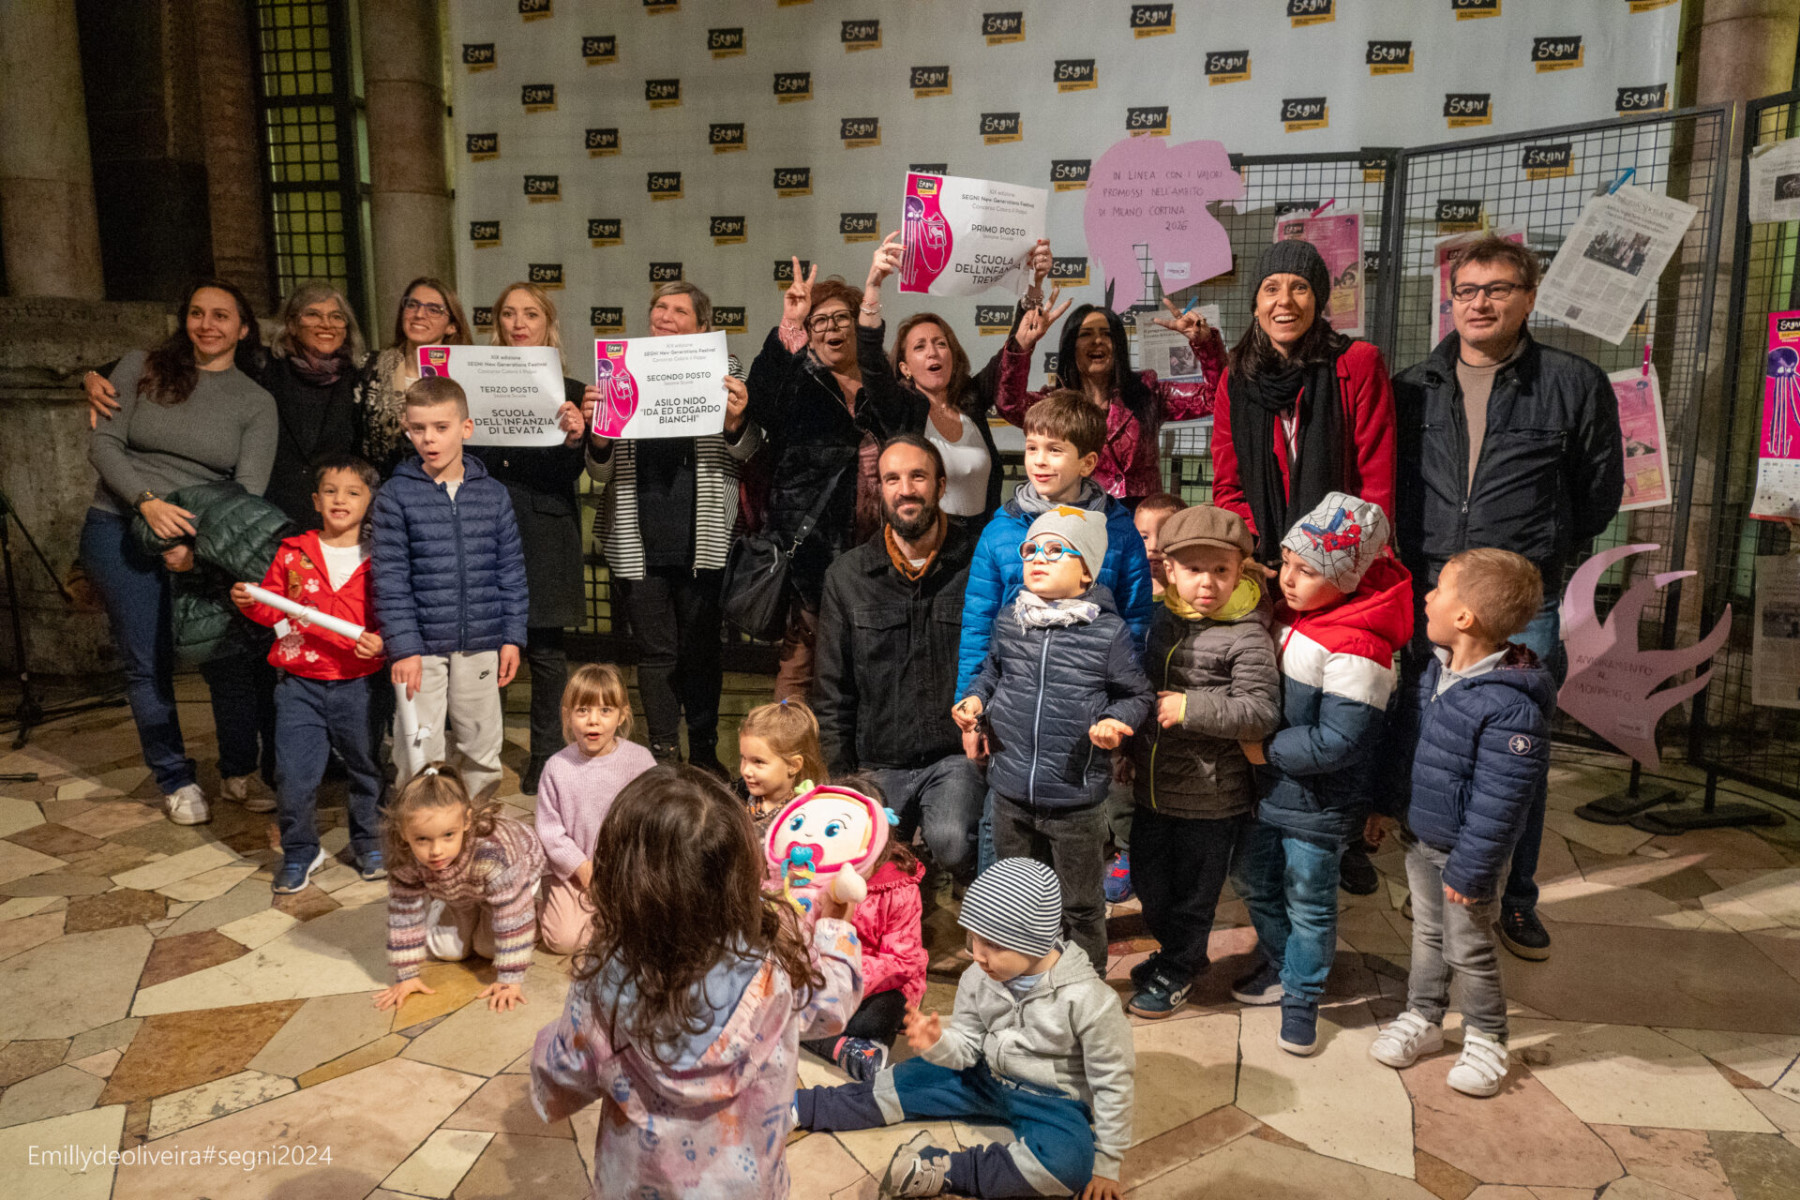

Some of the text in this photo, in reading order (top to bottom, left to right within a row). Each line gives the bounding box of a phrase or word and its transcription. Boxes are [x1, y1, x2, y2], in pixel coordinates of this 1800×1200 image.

[1136, 9, 1168, 24] Segni
[987, 17, 1017, 32] Segni
[845, 25, 874, 39] Segni
[711, 33, 739, 46] Segni
[1371, 45, 1406, 61] Segni
[1538, 41, 1575, 58] Segni
[1210, 55, 1243, 70] Segni
[915, 70, 944, 85] Segni
[1059, 64, 1089, 79] Segni
[778, 76, 806, 90] Segni
[649, 84, 676, 97] Segni
[1449, 97, 1484, 113] Segni
[1622, 91, 1660, 108] Segni
[1287, 103, 1320, 118] Segni
[985, 117, 1015, 131] Segni
[1132, 112, 1162, 126] Segni
[713, 128, 740, 142] Segni
[845, 122, 873, 136] Segni
[1528, 149, 1565, 164] Segni
[1055, 164, 1086, 179] Segni
[1113, 172, 1121, 180] IN
[1128, 171, 1156, 181] LINEA
[1165, 171, 1182, 179] CON
[1196, 170, 1223, 181] VALORI
[651, 177, 677, 190] Segni
[778, 172, 806, 185] Segni
[527, 180, 554, 193] Segni
[1103, 187, 1204, 198] PROMOSSI NELL'AMBITO
[1112, 206, 1142, 217] MILANO
[1149, 205, 1185, 216] CORTINA
[1441, 204, 1475, 219] Segni
[592, 223, 618, 236] Segni
[714, 221, 740, 233] Segni
[844, 217, 872, 231] Segni
[971, 223, 1026, 237] PRIMO POSTO
[1165, 220, 1190, 231] 2026
[975, 254, 1014, 265] SCUOLA
[654, 267, 679, 280] Segni
[1052, 261, 1082, 275] Segni
[532, 269, 558, 282] Segni
[594, 311, 620, 324] Segni
[715, 311, 741, 324] Segni
[980, 309, 1009, 322] Segni
[646, 371, 712, 382] SECONDO POSTO
[654, 396, 707, 407] ASILO NIDO
[491, 409, 535, 417] SCUOLA
[662, 407, 674, 415] ED
[676, 405, 721, 415] EDGARDO
[474, 417, 555, 427] DELL'INFANZIA
[659, 414, 700, 424] BIANCHI"
[489, 426, 544, 435] DI LEVATA
